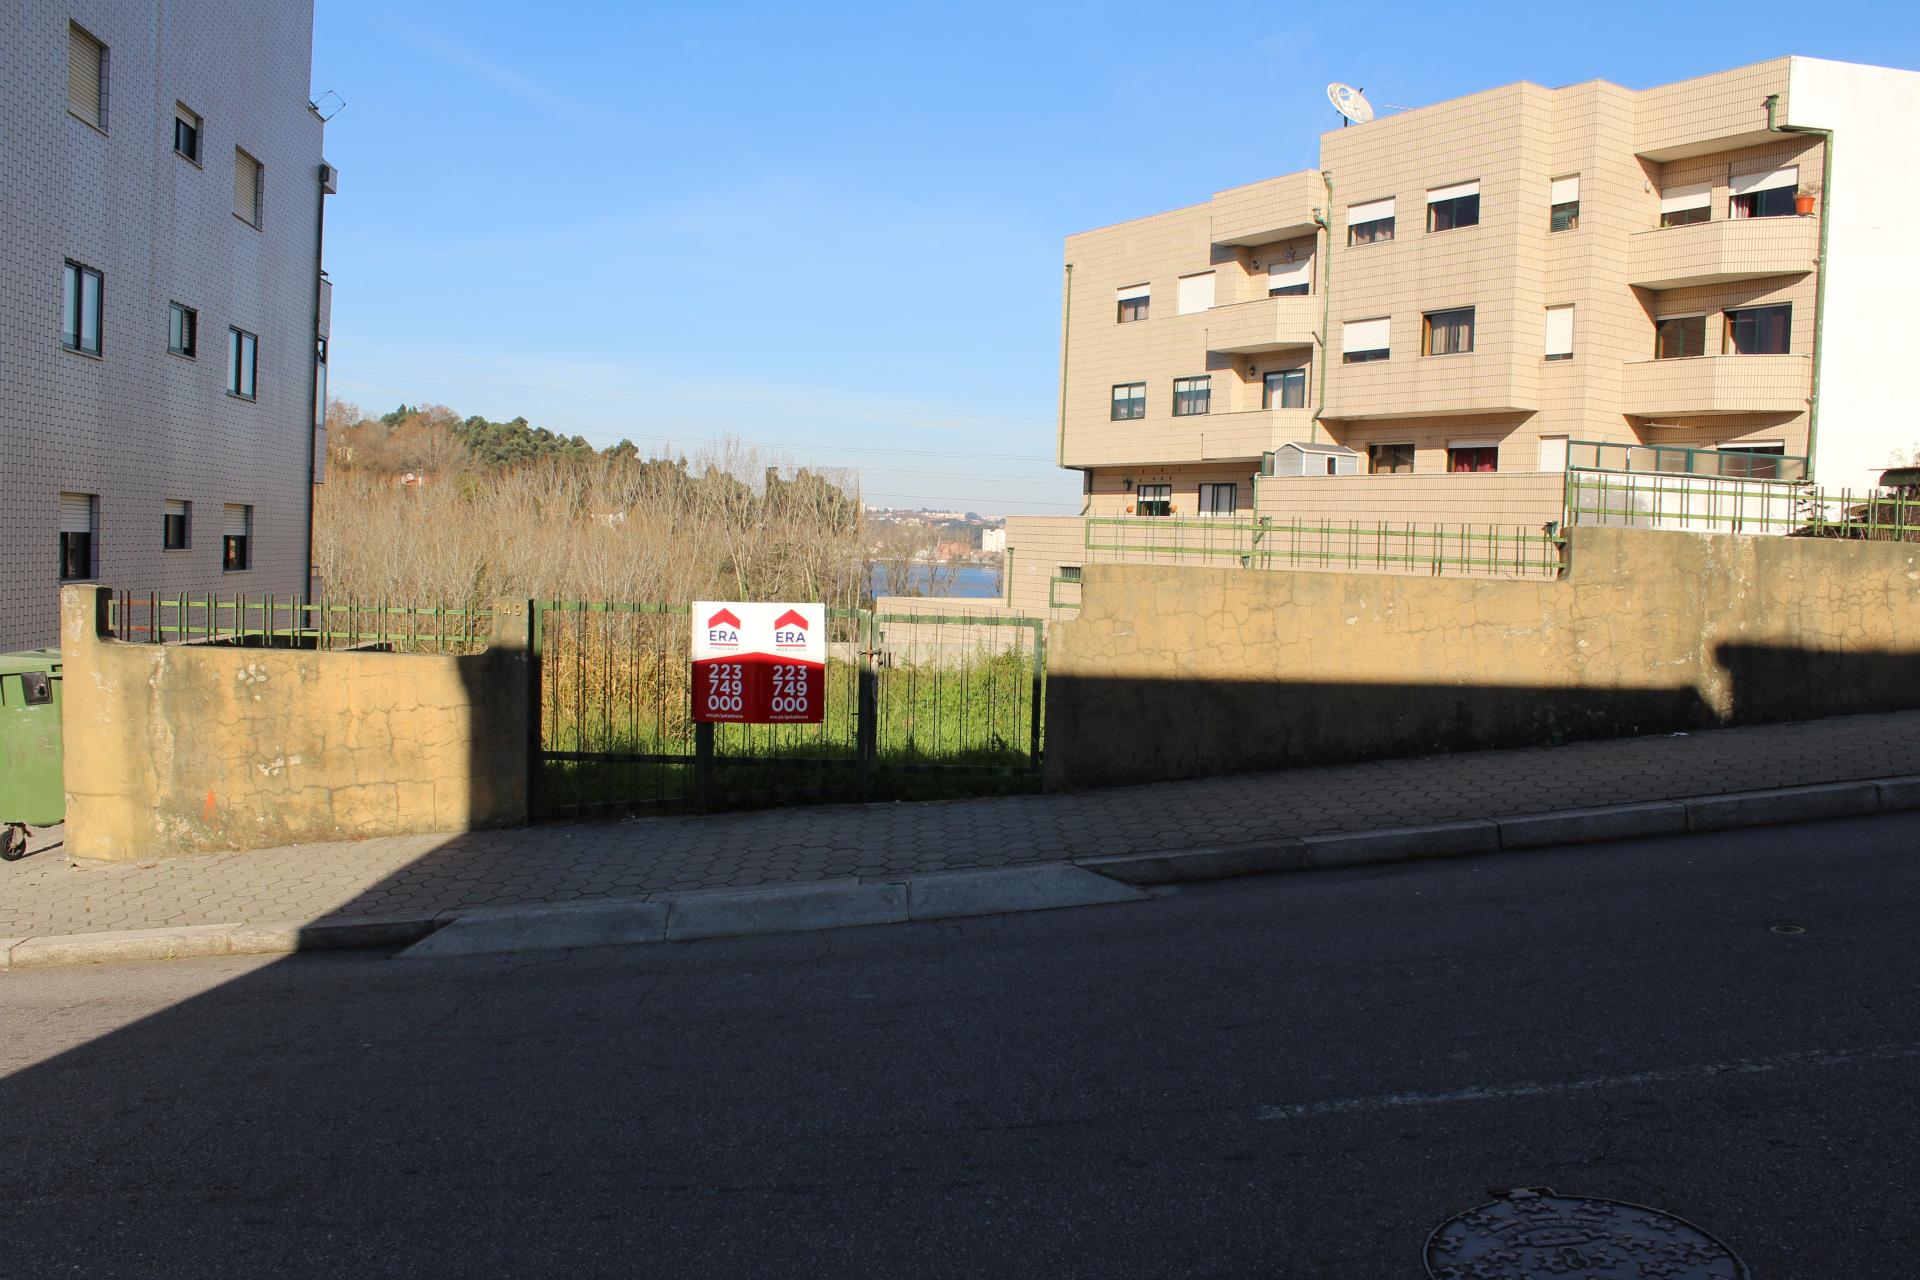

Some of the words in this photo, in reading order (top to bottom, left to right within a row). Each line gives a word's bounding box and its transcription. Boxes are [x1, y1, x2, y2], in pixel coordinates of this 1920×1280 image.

[496, 603, 522, 616] 149
[709, 630, 738, 642] ERA
[775, 631, 806, 643] ERA
[709, 663, 742, 679] 223
[773, 665, 807, 680] 223
[709, 680, 742, 696] 749
[773, 681, 808, 697] 749
[707, 695, 743, 711] 000
[771, 697, 808, 712] 000
